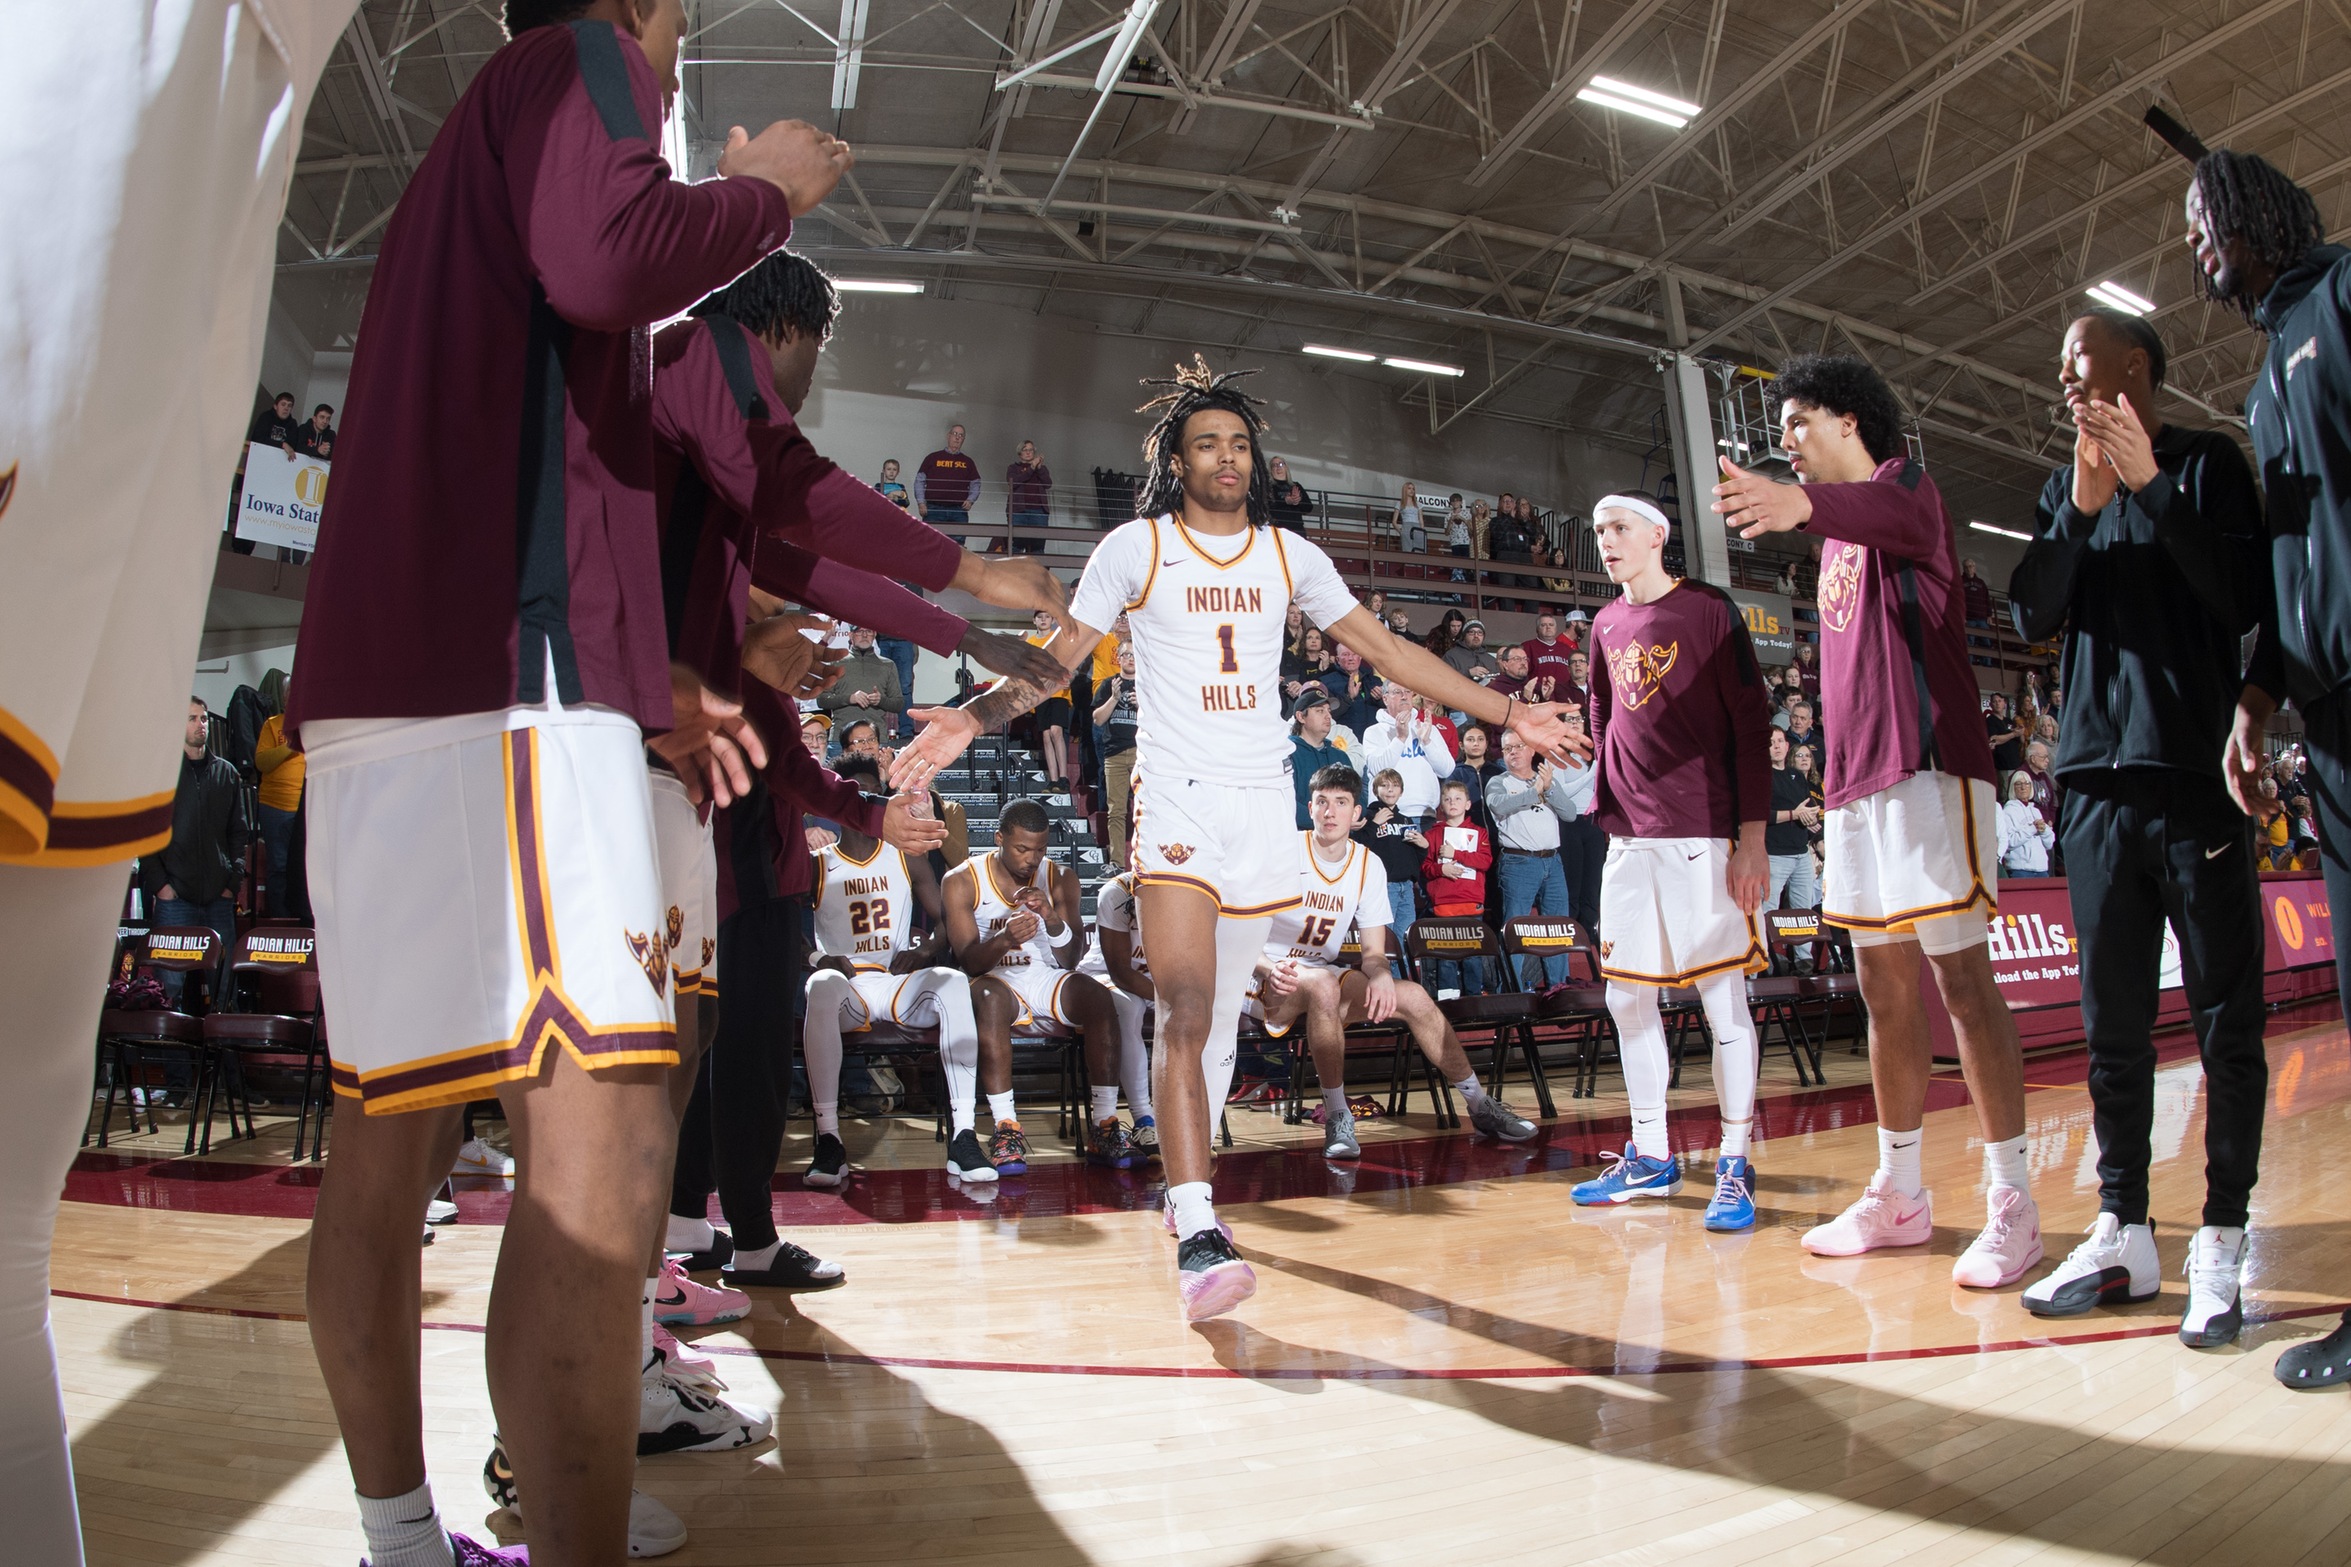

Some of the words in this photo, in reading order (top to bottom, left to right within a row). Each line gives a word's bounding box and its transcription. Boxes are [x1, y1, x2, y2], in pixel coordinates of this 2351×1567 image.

[246, 493, 285, 516] Iowa
[289, 503, 320, 524] Stat
[1416, 496, 1451, 508] ALCONY
[245, 514, 316, 536] www.myiowasta
[1727, 539, 1744, 549] CONY
[1186, 586, 1263, 614] INDIAN
[1743, 607, 1779, 635] lls
[1216, 623, 1240, 675] 1
[1755, 638, 1769, 647] App
[1770, 639, 1793, 649] Today!
[1201, 685, 1257, 712] HILLS
[844, 875, 889, 897] INDIAN
[1304, 890, 1344, 912] INDIAN
[849, 898, 891, 936] 22
[1772, 916, 1798, 928] INDIAN
[1797, 915, 1820, 928] HILLS
[2275, 896, 2304, 950] 0
[1296, 914, 1337, 947] 15
[1418, 926, 1454, 940] INDIAN
[1455, 926, 1485, 939] HILLS
[1514, 923, 1546, 937] INDIAN
[1547, 923, 1577, 937] HILLS
[1987, 914, 2070, 961] Hills
[2067, 937, 2078, 953] T
[148, 934, 182, 950] INDIAN
[183, 935, 211, 951] HILLS
[246, 936, 284, 952] INDIAN
[284, 938, 314, 952] HILLS
[855, 935, 890, 954] HILLS
[1993, 970, 2022, 984] load
[2022, 969, 2040, 981] the
[2041, 967, 2061, 980] App
[2062, 964, 2079, 977] Tod
